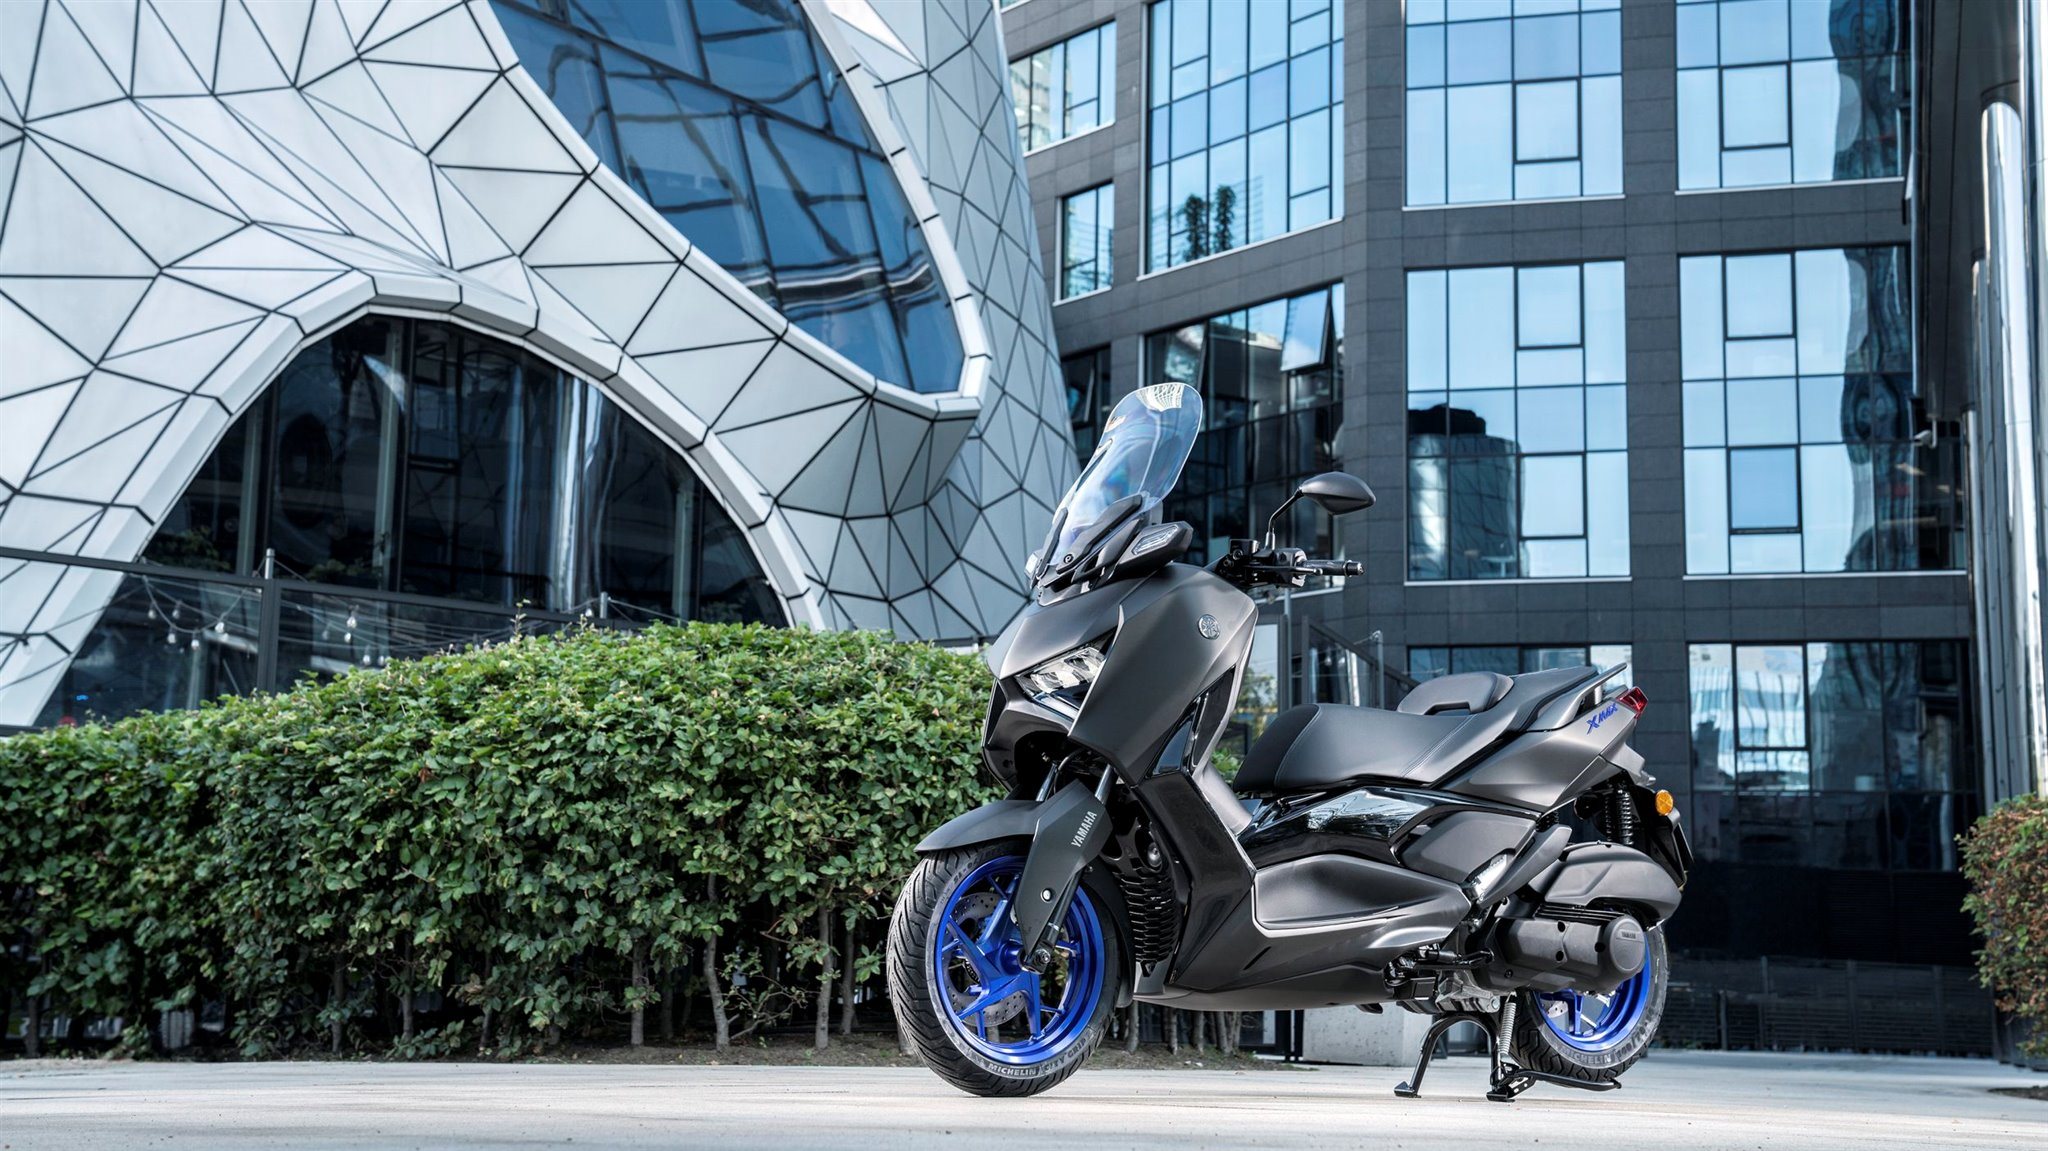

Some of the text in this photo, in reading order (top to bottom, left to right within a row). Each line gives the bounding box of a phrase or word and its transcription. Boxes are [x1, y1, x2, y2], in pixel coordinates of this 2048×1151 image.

[1071, 811, 1097, 847] YAMAHA
[1562, 1047, 1612, 1064] MICHELIN
[988, 1063, 1036, 1076] MICHELIN
[1044, 1056, 1065, 1071] CITY
